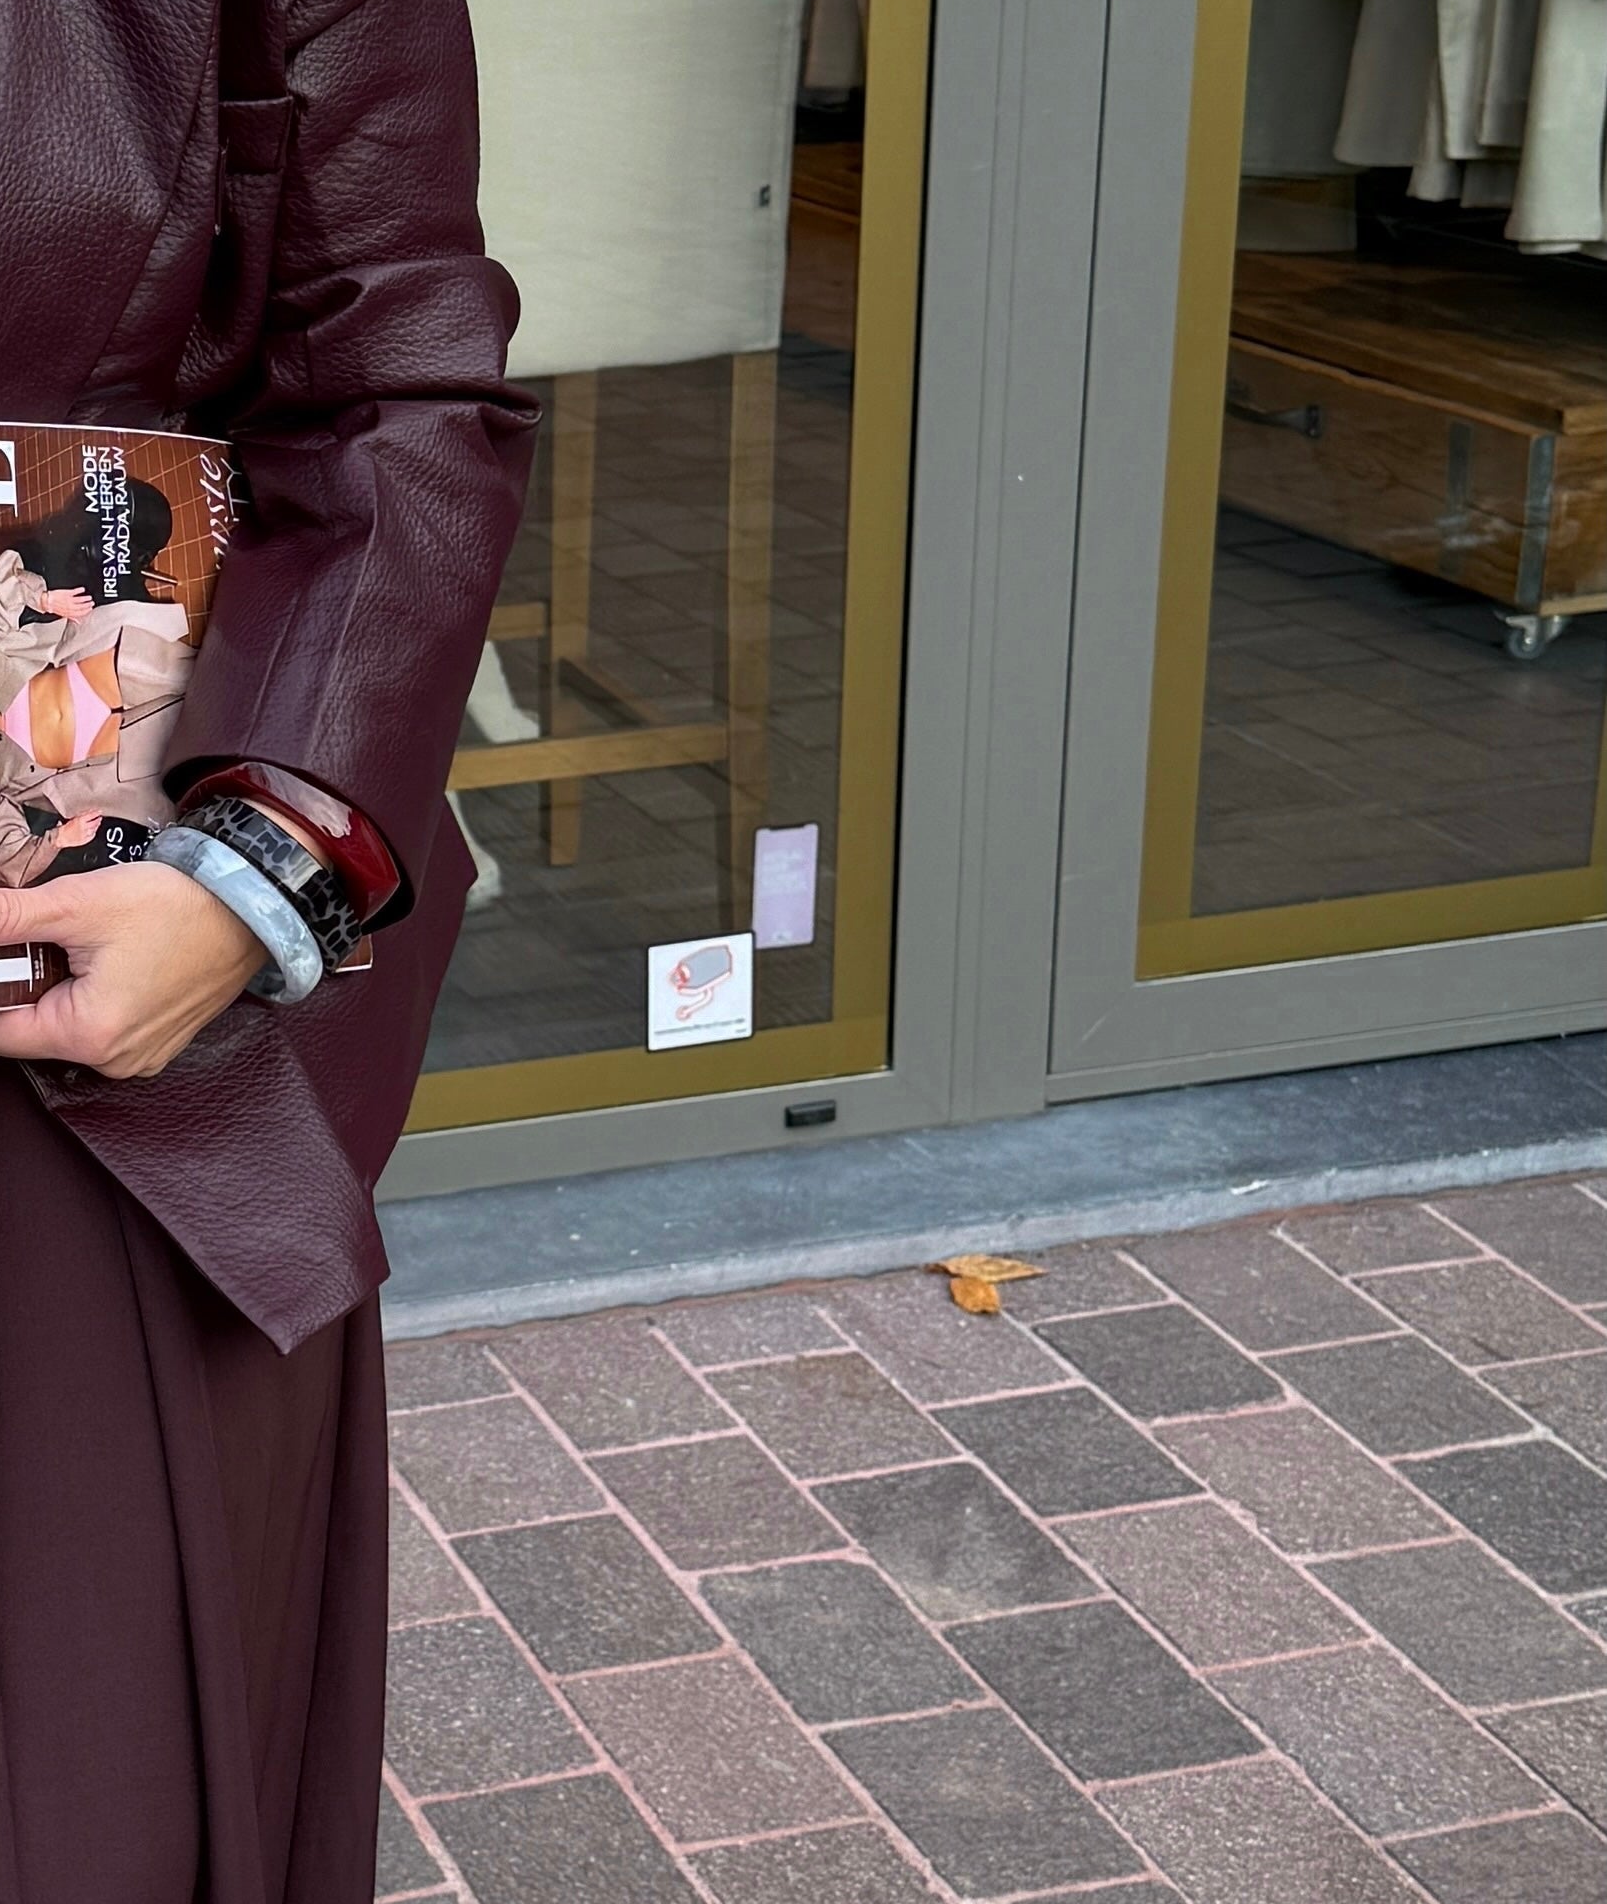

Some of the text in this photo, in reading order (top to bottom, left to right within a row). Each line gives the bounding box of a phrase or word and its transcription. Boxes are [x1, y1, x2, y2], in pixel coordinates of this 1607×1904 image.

[81, 444, 99, 513] MODE
[112, 446, 129, 505] RAUW
[98, 446, 119, 598] IRIS VAN HERPEN
